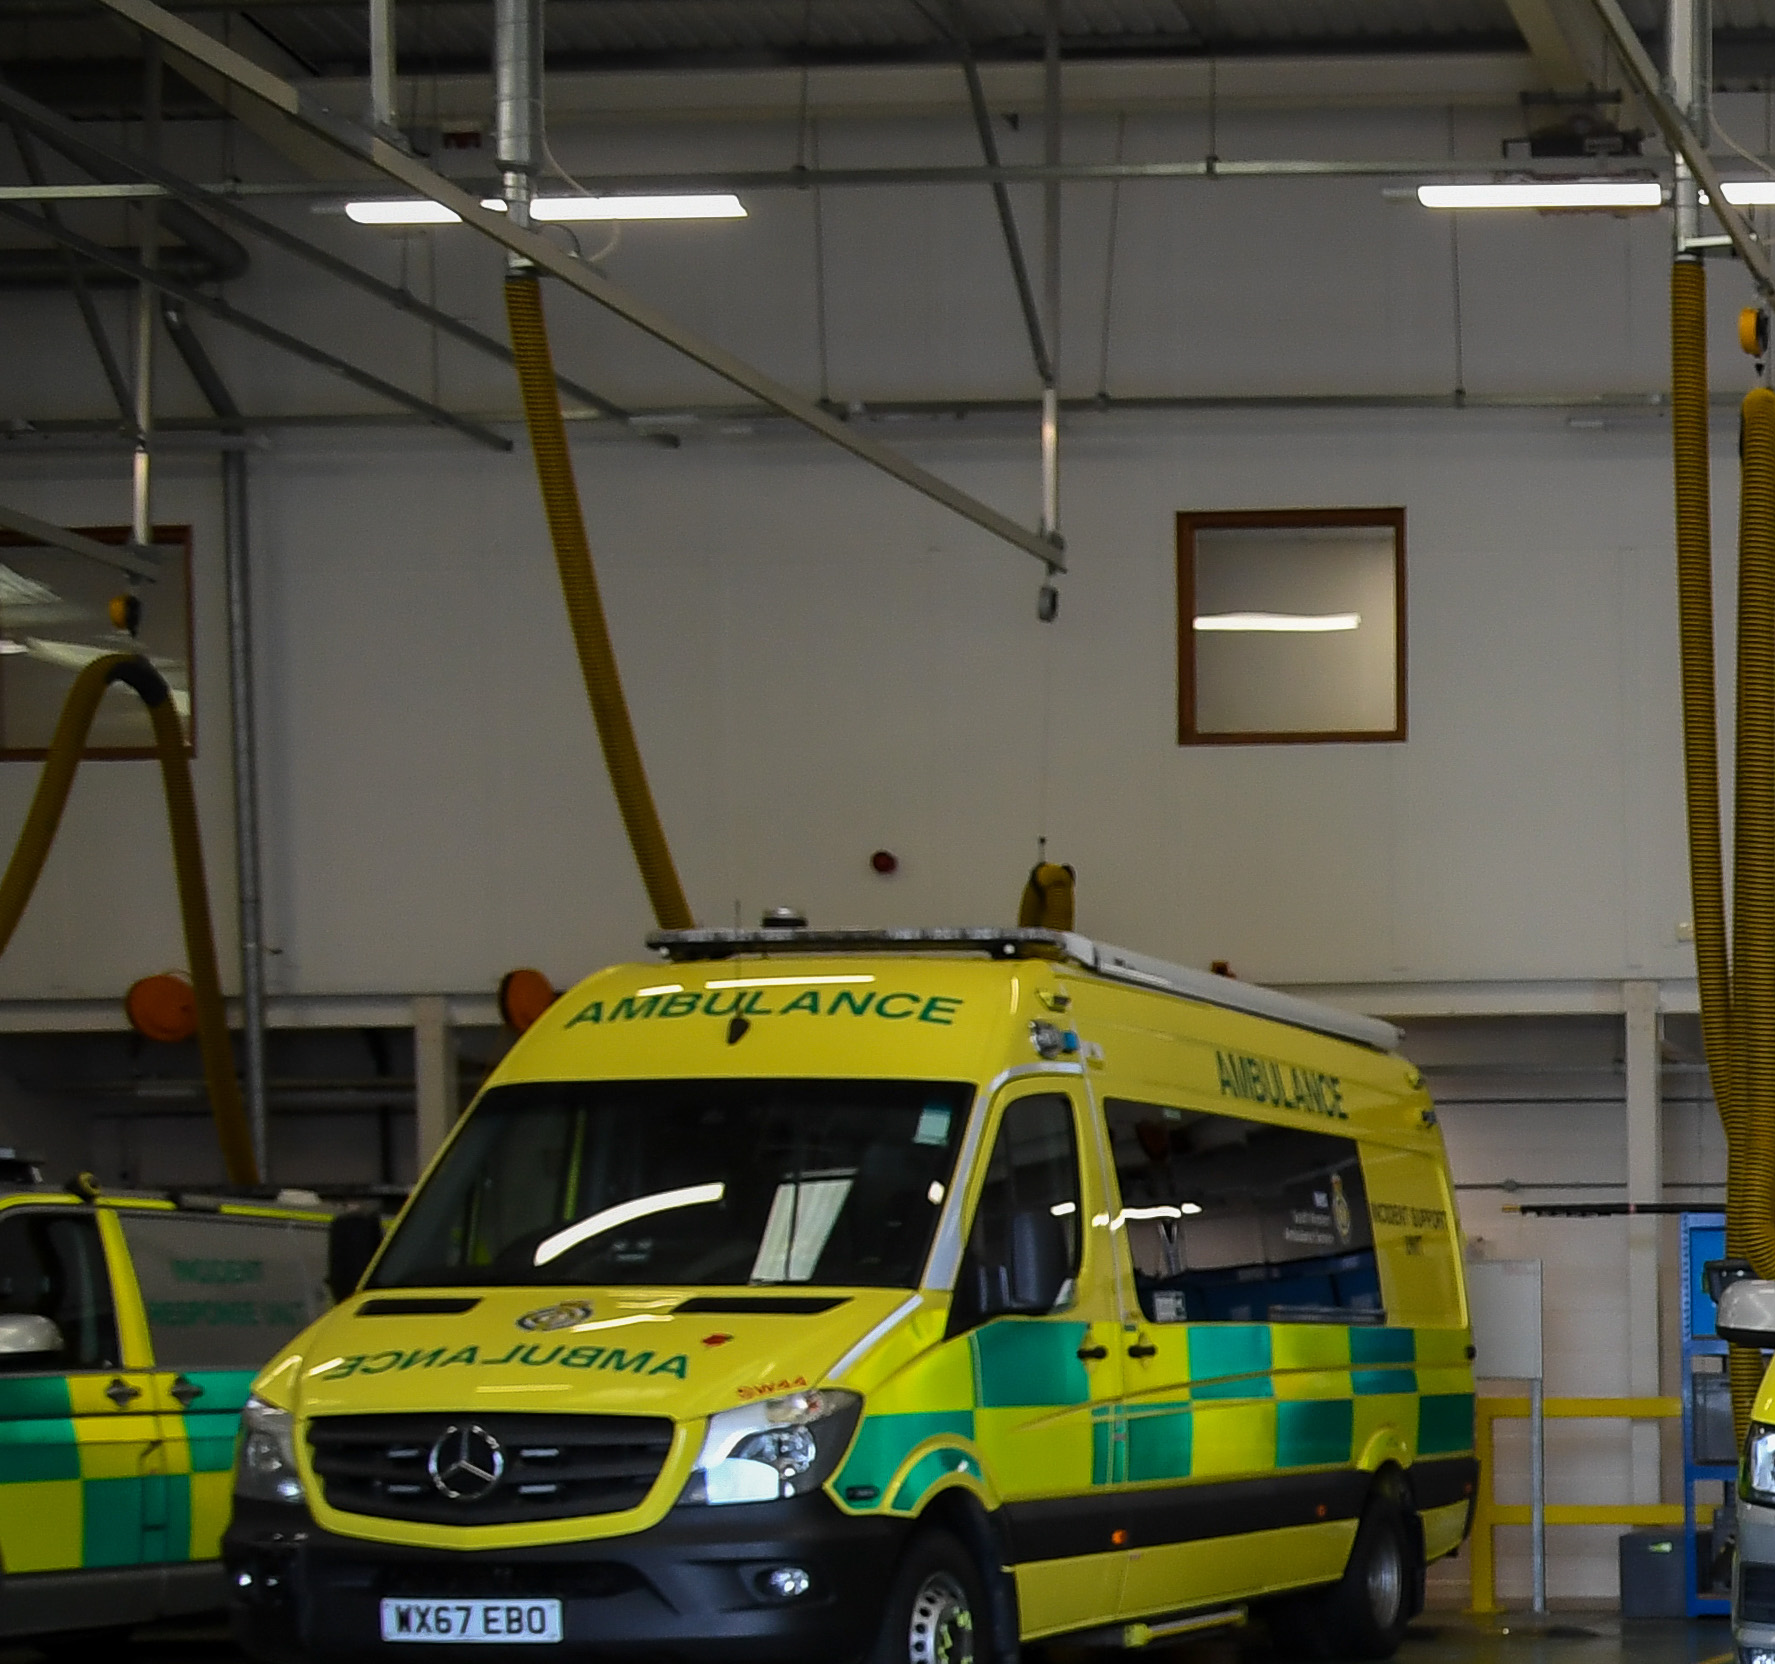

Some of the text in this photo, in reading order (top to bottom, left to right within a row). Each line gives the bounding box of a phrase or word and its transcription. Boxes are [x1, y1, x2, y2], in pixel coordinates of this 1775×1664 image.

[563, 989, 964, 1030] AMBULANCE
[1215, 1050, 1349, 1120] AMBULANCE
[396, 1605, 546, 1634] WX67 EBO
